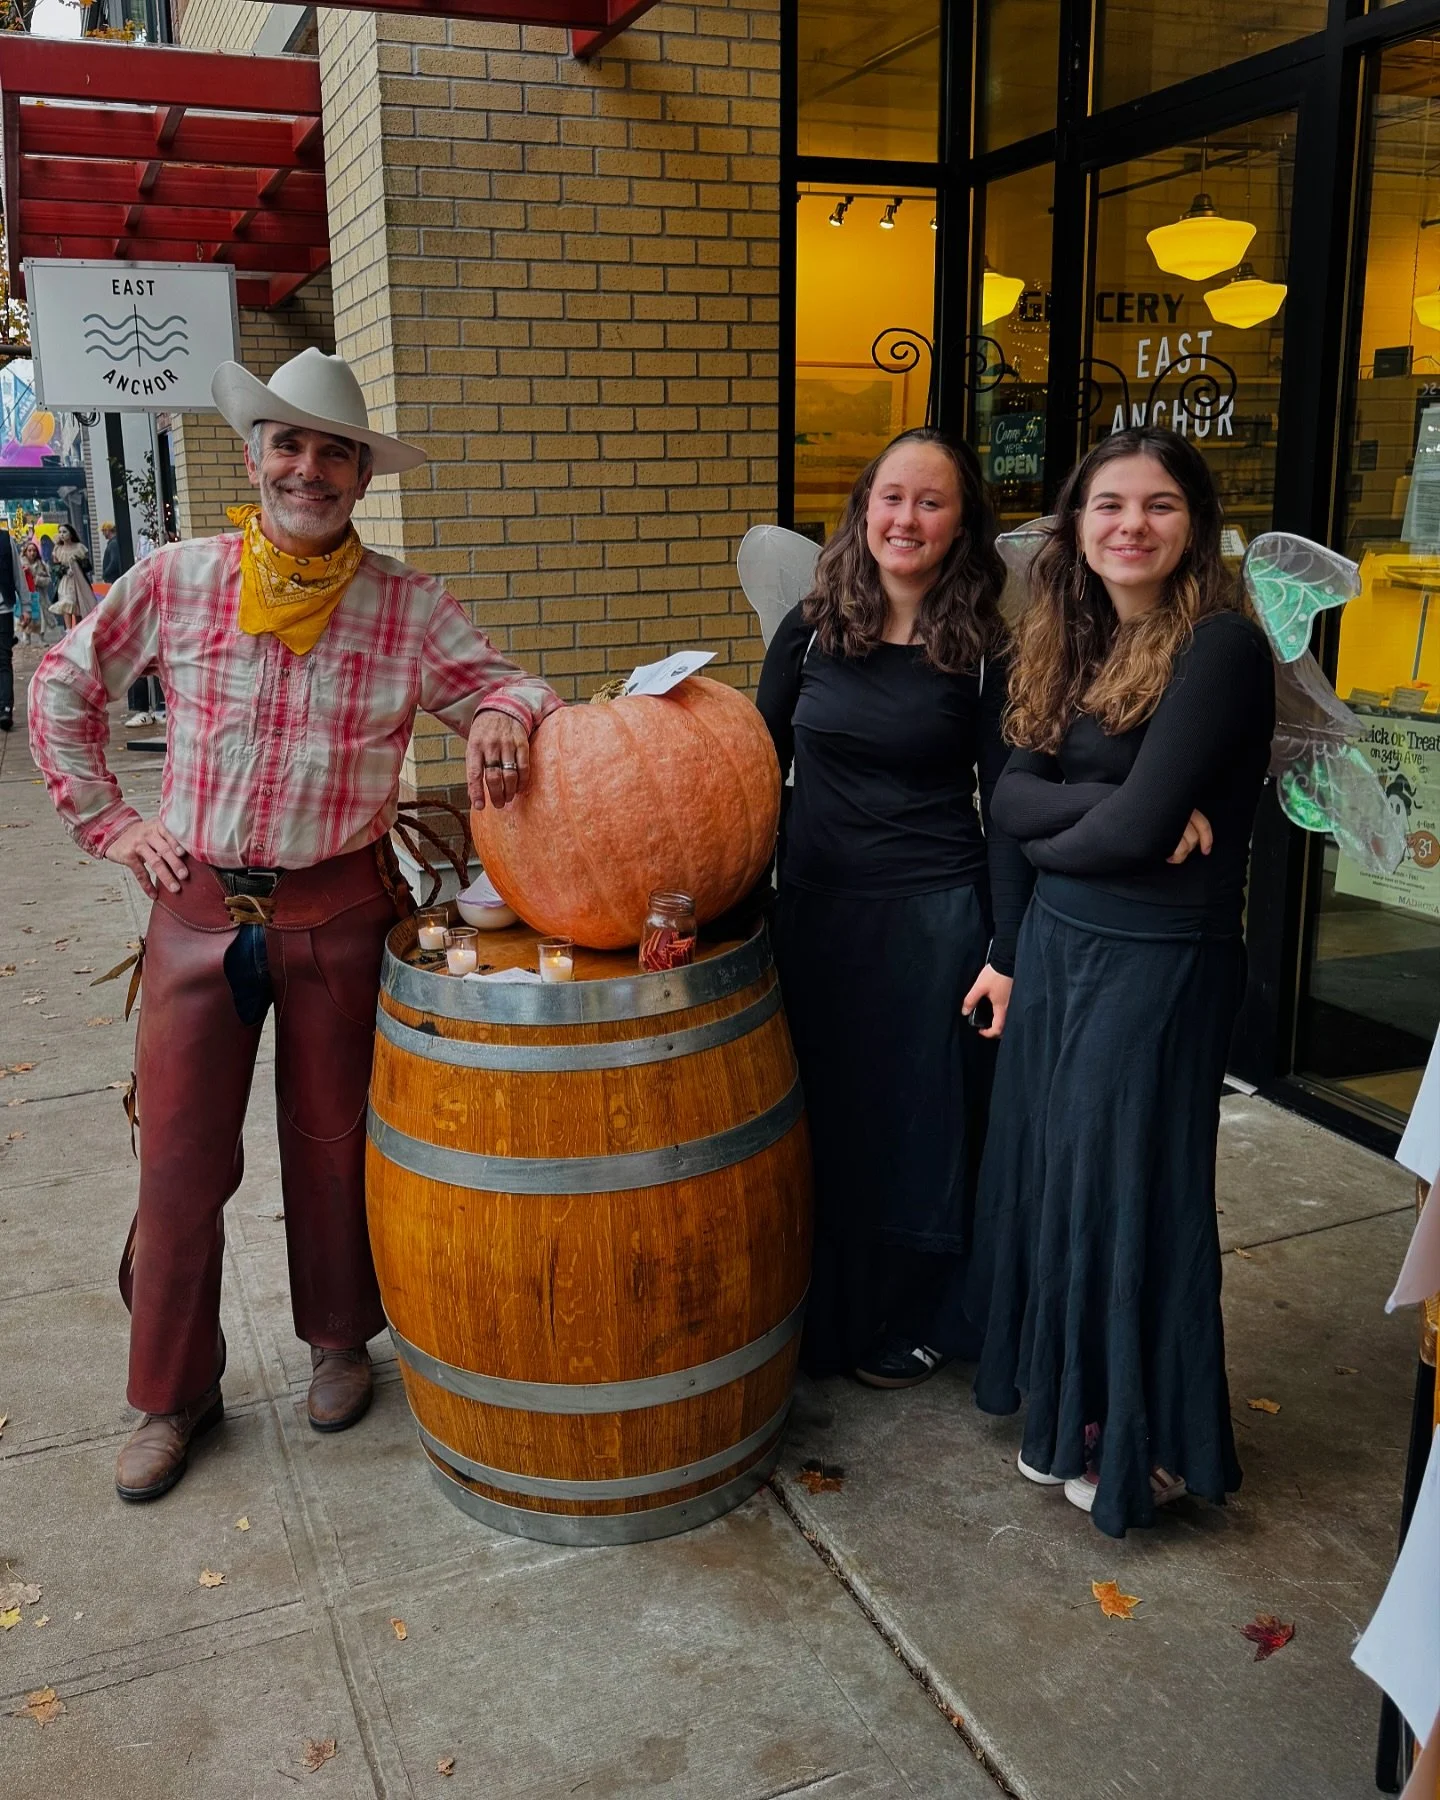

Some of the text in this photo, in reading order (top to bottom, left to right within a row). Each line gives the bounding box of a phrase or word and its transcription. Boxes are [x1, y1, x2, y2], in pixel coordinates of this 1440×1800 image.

[112, 279, 155, 296] EAST
[1018, 291, 1184, 324] GCERY
[1137, 330, 1213, 379] EAST
[102, 368, 179, 396] ANCHOR
[994, 453, 1038, 476] OPEN
[1391, 731, 1406, 748] or
[1370, 747, 1422, 766] on 34th Ave
[1418, 838, 1433, 858] 31
